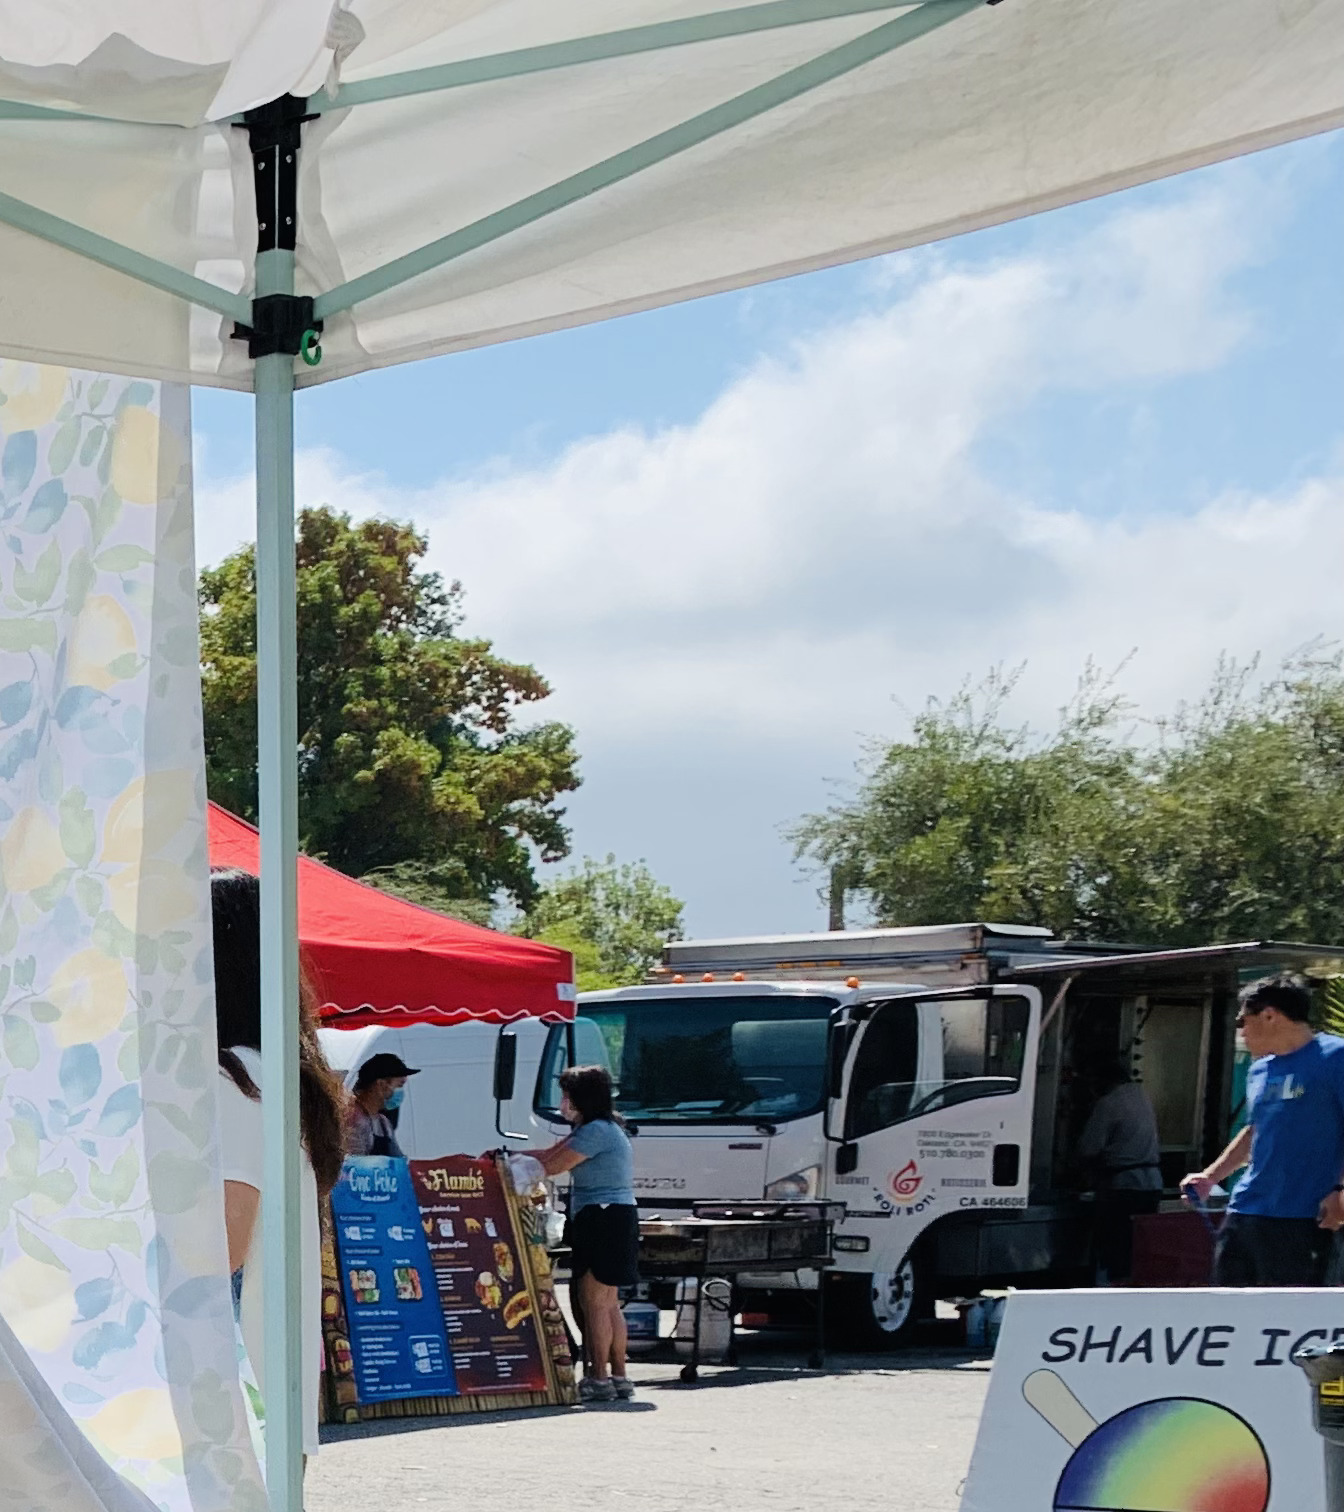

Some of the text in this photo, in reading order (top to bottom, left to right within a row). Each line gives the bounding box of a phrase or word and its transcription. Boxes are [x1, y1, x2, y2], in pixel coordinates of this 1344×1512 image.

[426, 1168, 485, 1191] Flambé
[959, 1197, 977, 1207] CA
[1042, 1325, 1235, 1367] SHAVE
